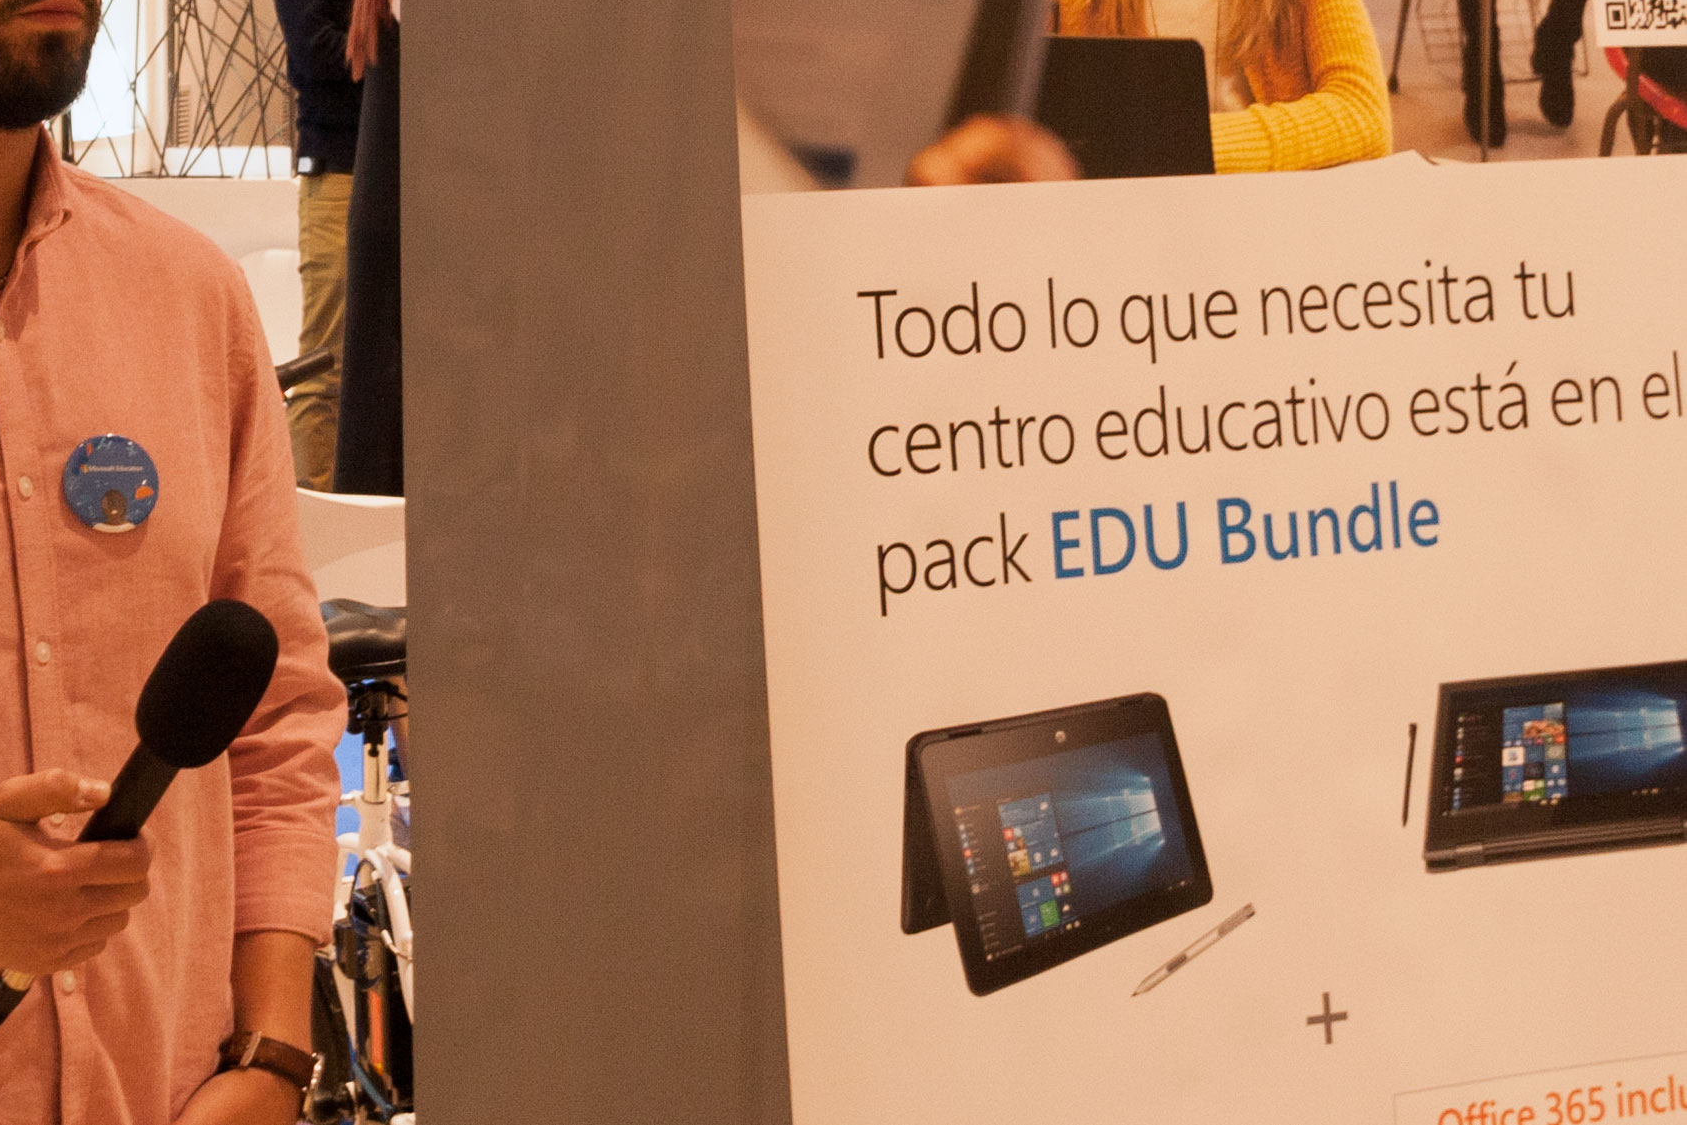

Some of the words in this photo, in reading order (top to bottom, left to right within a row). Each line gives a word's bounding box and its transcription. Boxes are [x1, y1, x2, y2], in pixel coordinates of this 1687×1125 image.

[857, 282, 1027, 360] Todo
[1048, 277, 1099, 349] lo
[1119, 287, 1239, 364] que
[1260, 261, 1495, 336] necesita
[1514, 261, 1576, 319] tu
[868, 404, 1075, 477] centro
[1095, 377, 1390, 460] educativo
[1409, 360, 1529, 436] está
[1550, 372, 1623, 425] en
[1642, 351, 1684, 418] el
[876, 512, 1032, 617] pack
[1051, 501, 1189, 579] EDU
[1217, 480, 1440, 564] Bundle
[1546, 1085, 1605, 1125] 365
